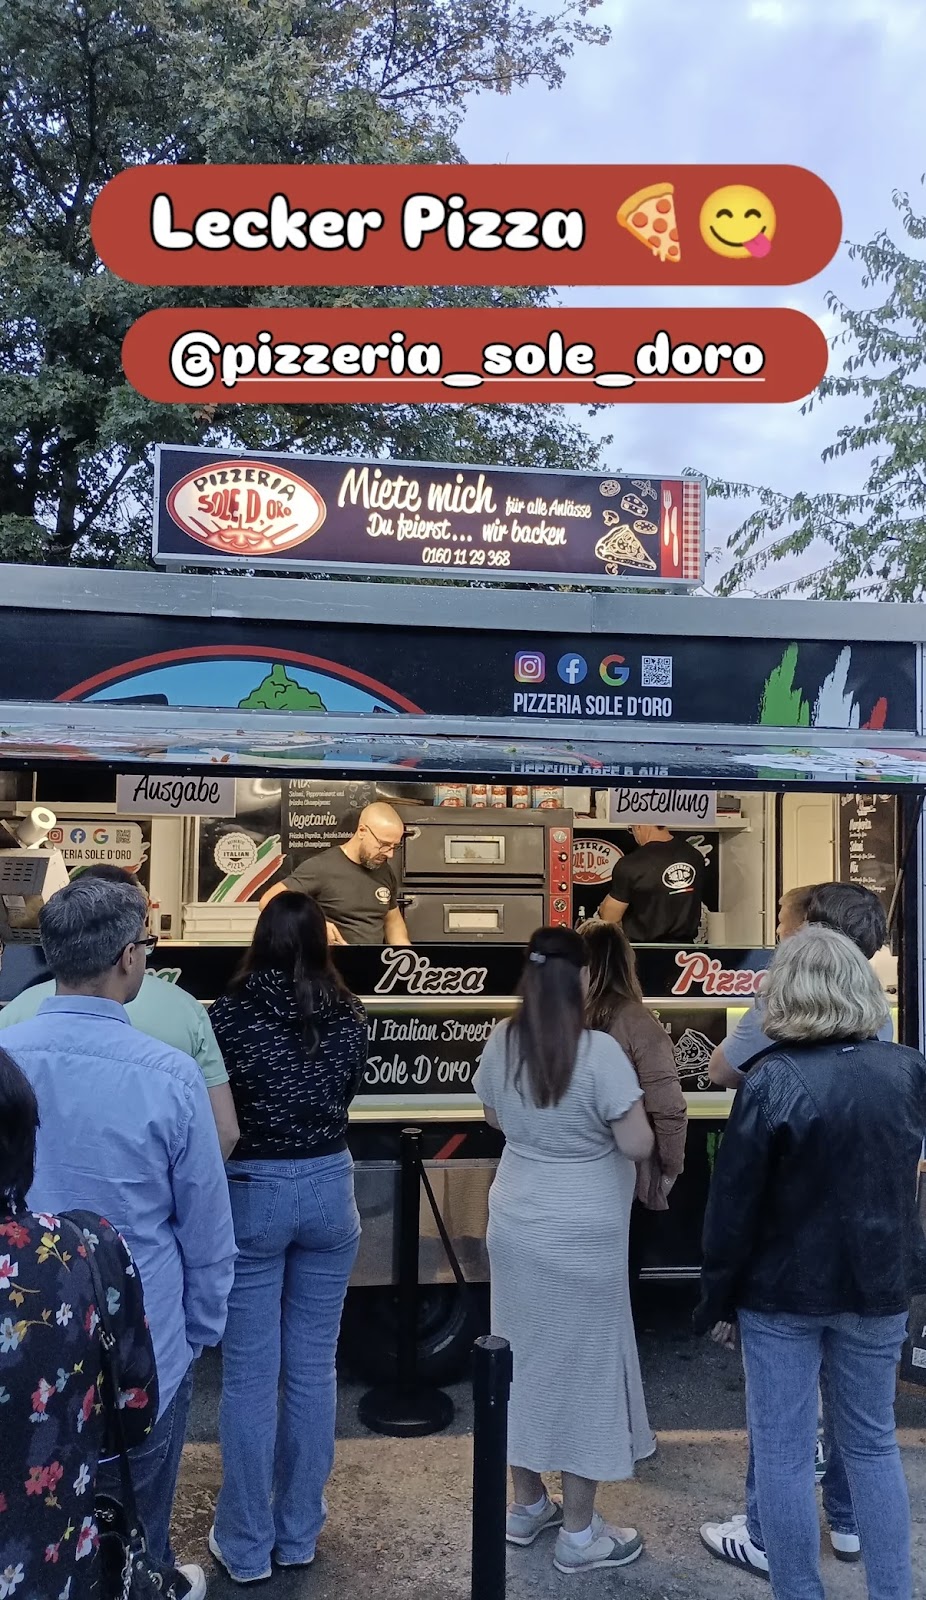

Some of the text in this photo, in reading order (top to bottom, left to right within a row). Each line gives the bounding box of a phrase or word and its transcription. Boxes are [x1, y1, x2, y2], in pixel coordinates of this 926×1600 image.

[193, 468, 296, 501] PIZZERIA
[338, 467, 592, 519] Miete mich für alle Anlässe
[198, 488, 240, 523] SOLE
[366, 512, 394, 537] Du
[482, 518, 508, 542] wir
[511, 518, 567, 545] backen
[422, 547, 511, 567] 0160 11 29 368
[513, 692, 672, 717] PIZZERIA SOLE D'ORO
[133, 775, 221, 808] Ausgabe
[615, 788, 710, 818] Bestellung
[288, 811, 338, 830] Vegetaria
[84, 849, 105, 860] SOLE
[107, 849, 132, 860] D'ORO
[572, 851, 585, 869] OLE
[573, 842, 611, 857] ZZERIA
[374, 947, 488, 994] Pizza
[380, 1018, 439, 1041] Italian
[441, 1017, 496, 1042] Street
[364, 1053, 471, 1085] Sole D'oro
